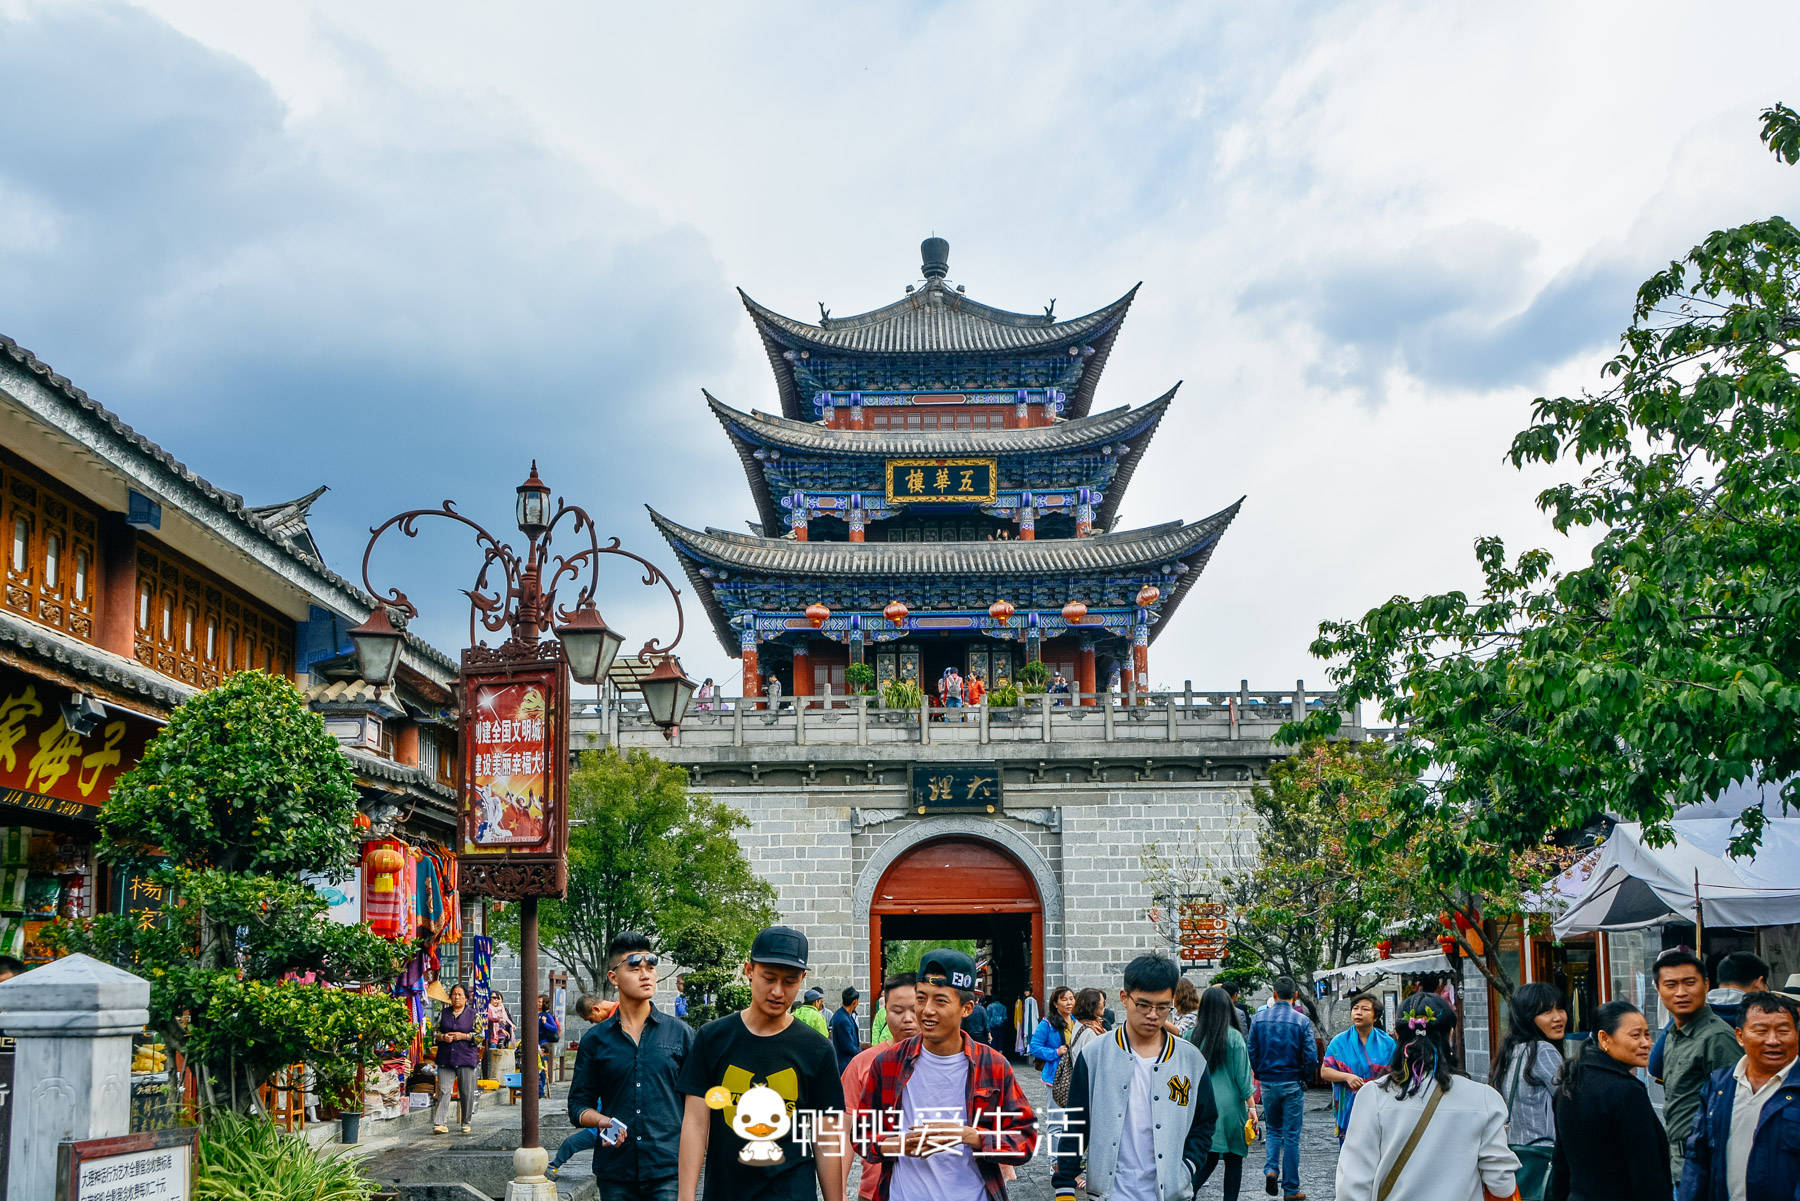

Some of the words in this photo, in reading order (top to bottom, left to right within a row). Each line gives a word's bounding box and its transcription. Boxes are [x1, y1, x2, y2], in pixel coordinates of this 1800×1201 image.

[475, 719, 545, 744] 创建全国文明城
[3, 790, 23, 805] JIA
[25, 795, 55, 811] PLUM
[56, 801, 84, 816] SHOP
[1167, 1075, 1191, 1106] NY
